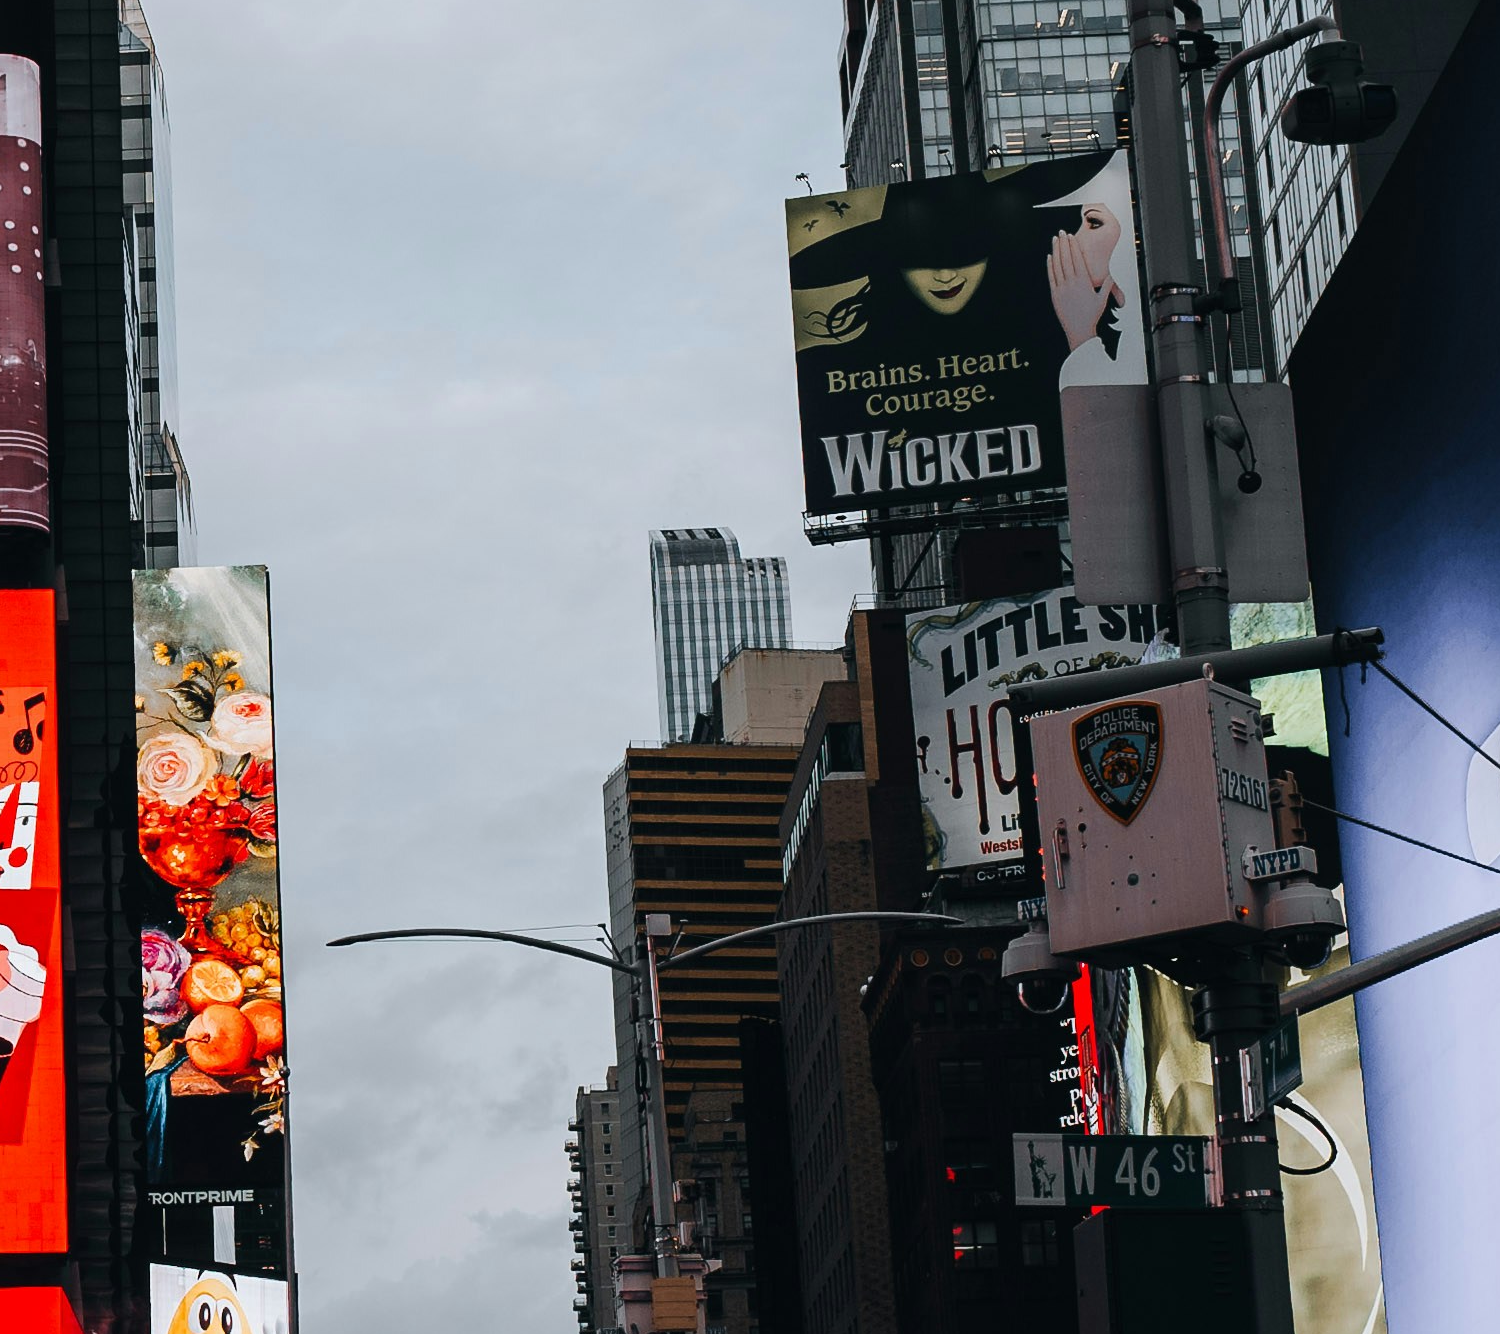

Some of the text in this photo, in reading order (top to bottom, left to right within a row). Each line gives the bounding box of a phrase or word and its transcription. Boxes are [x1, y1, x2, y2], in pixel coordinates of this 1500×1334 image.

[826, 347, 1030, 396] Brains. Heart.
[865, 382, 995, 418] Courage.
[940, 598, 1088, 695] LITTLE
[1055, 657, 1083, 675] OF
[1079, 721, 1155, 750] DEPARTMENT
[1094, 708, 1139, 726] POLICE
[1082, 741, 1157, 805] CITY OF NEW YORK
[1222, 769, 1268, 811] 7-26161
[1252, 849, 1300, 877] NYPD
[1068, 1143, 1196, 1197] W 46 St
